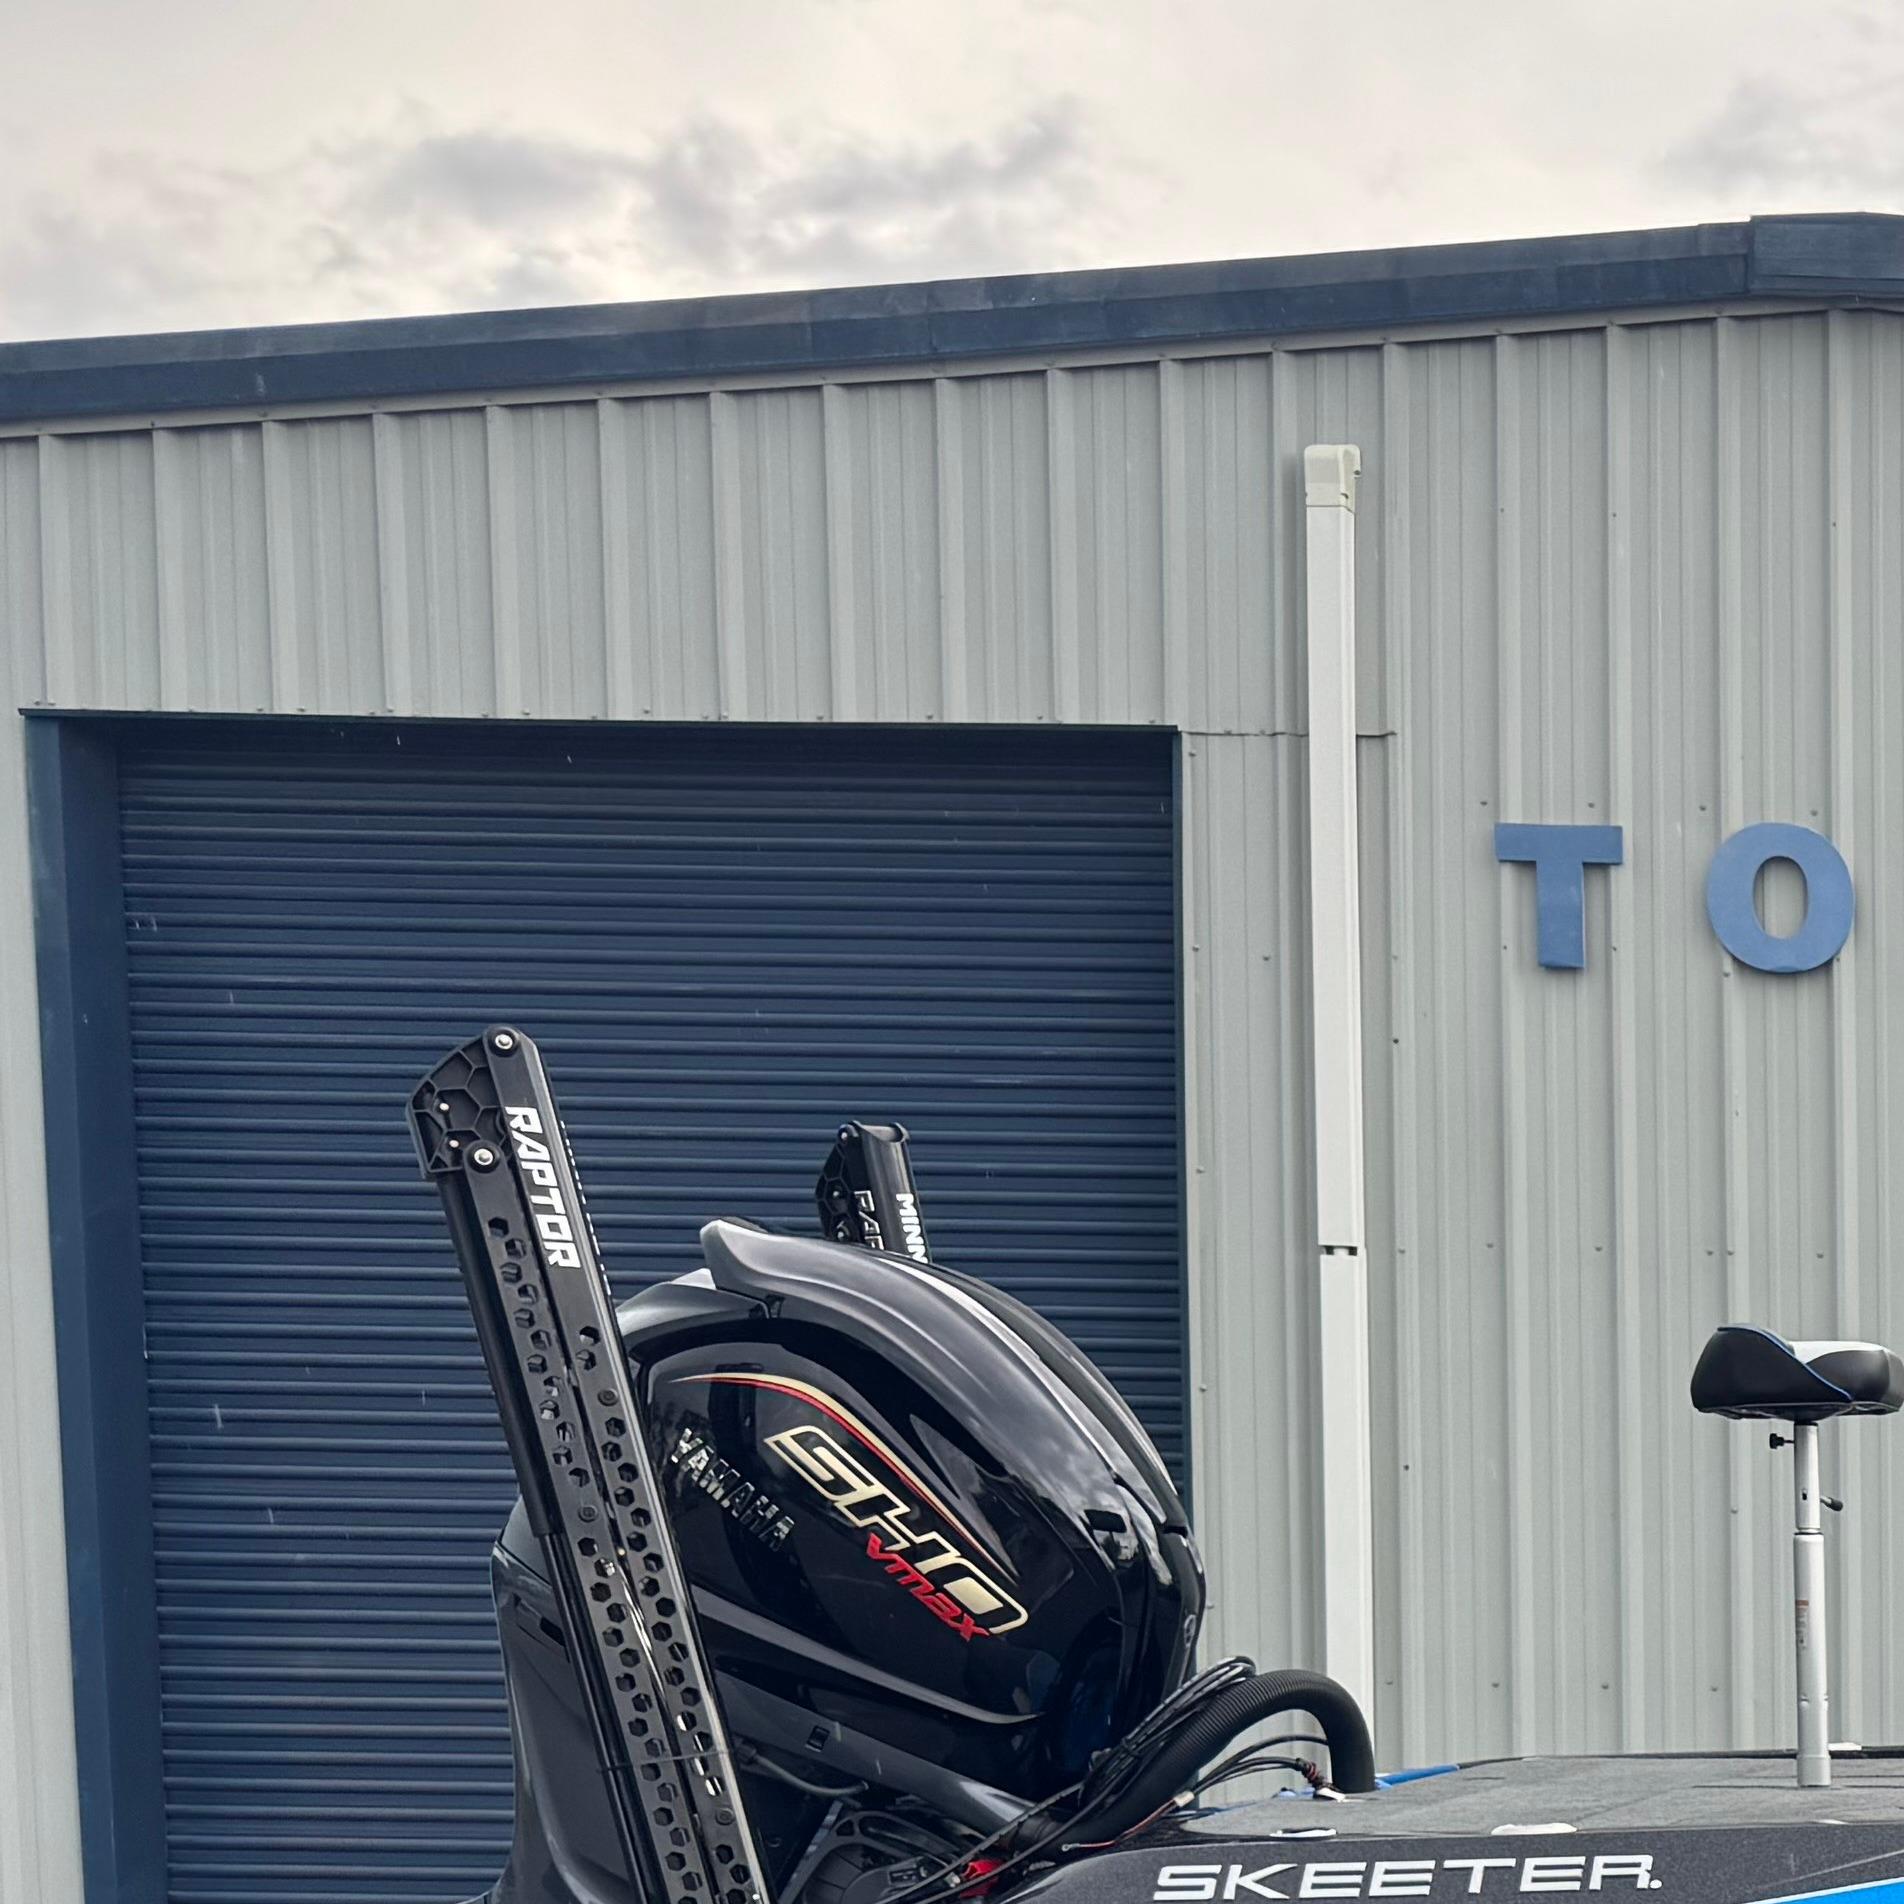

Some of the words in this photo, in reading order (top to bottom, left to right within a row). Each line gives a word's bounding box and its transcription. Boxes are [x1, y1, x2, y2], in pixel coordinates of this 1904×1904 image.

[505, 1106, 581, 1268] RAPTOR
[671, 1428, 795, 1552] YAMAHA
[764, 1425, 1028, 1635] SHO
[1153, 1855, 1662, 1900] SKEETER
